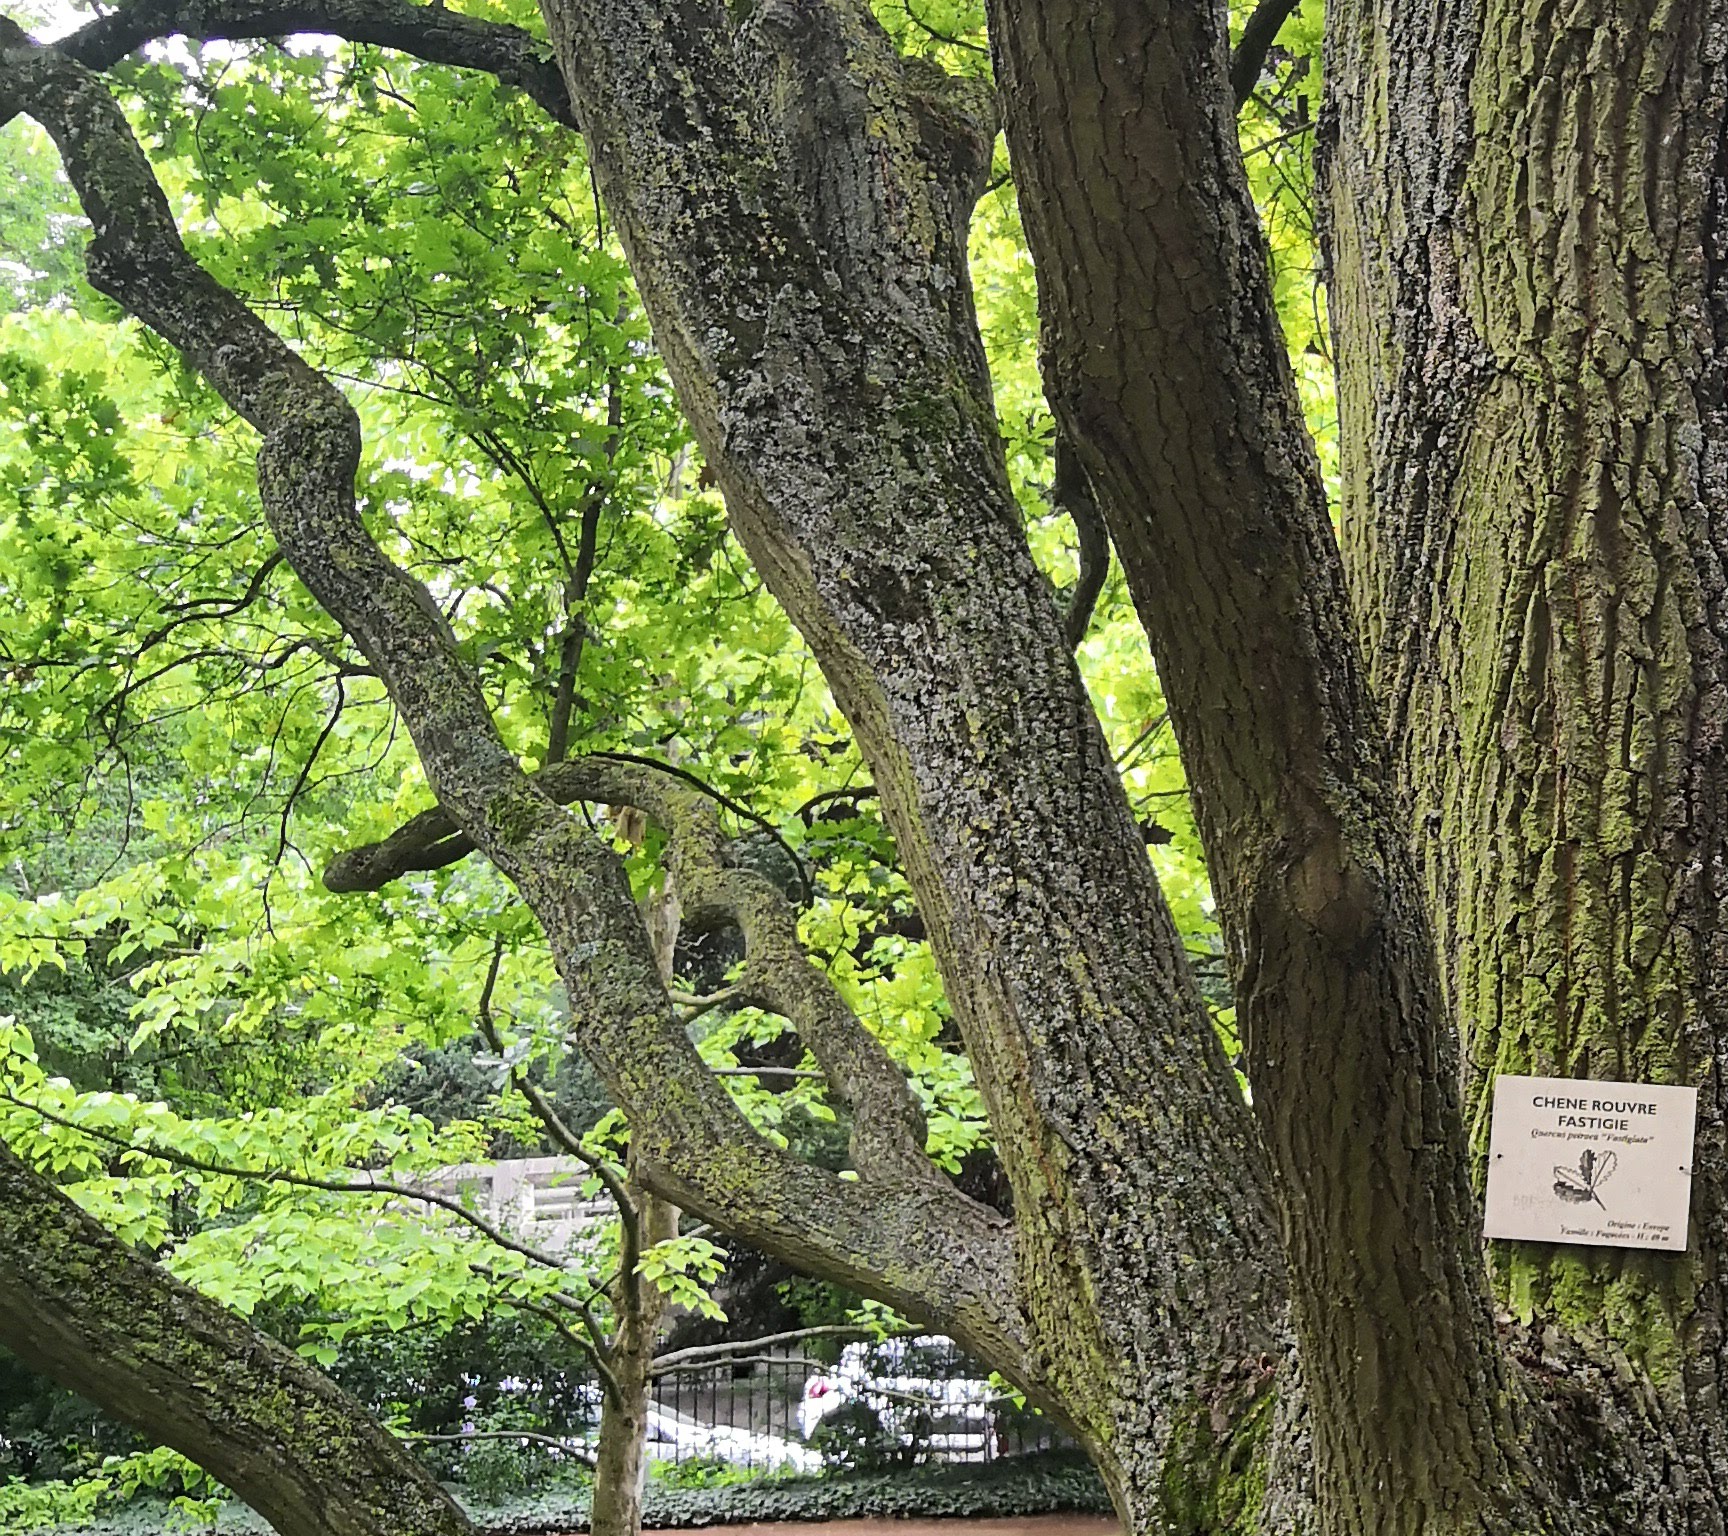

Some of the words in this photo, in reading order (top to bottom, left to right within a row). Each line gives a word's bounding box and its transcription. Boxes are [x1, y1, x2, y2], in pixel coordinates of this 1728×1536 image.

[1532, 1096, 1588, 1111] CHENE
[1592, 1100, 1657, 1115] ROUVRE
[1558, 1115, 1629, 1131] FASTIGIE
[1531, 1128, 1566, 1139] Quercus
